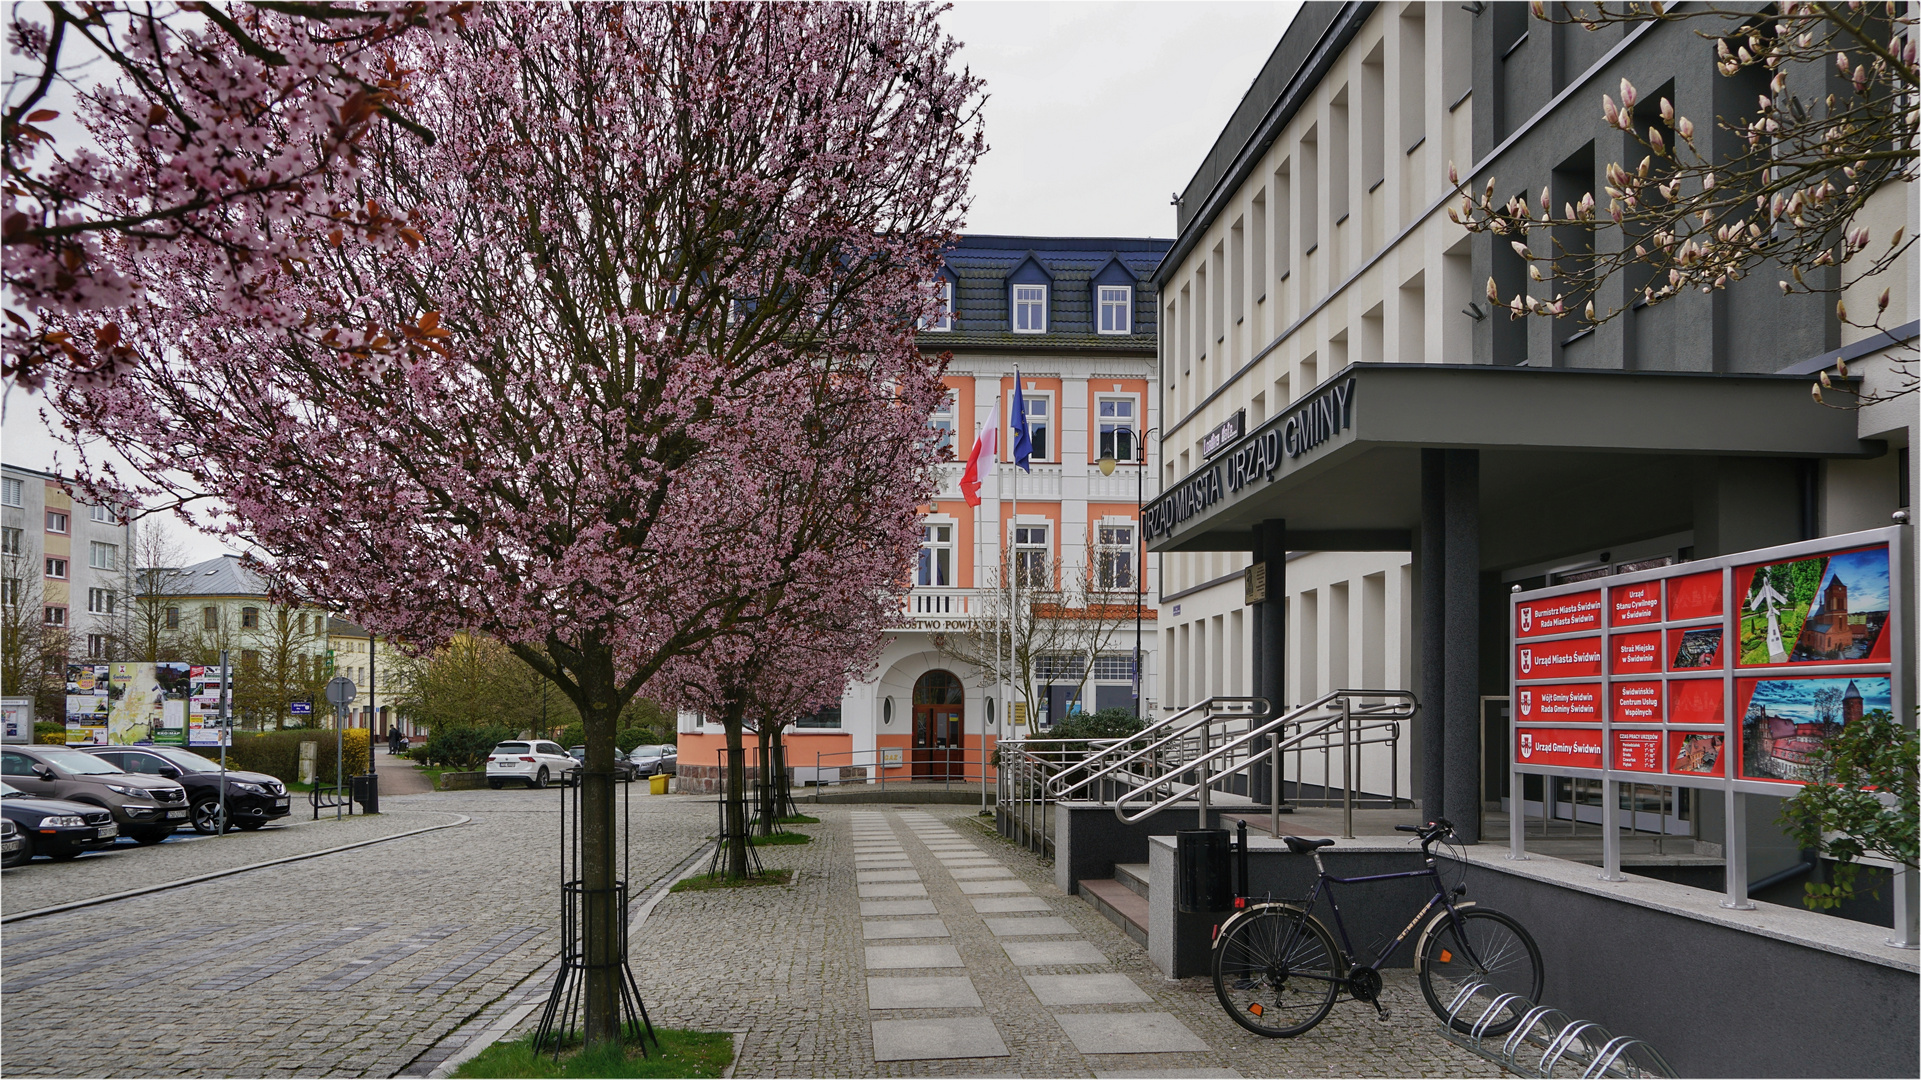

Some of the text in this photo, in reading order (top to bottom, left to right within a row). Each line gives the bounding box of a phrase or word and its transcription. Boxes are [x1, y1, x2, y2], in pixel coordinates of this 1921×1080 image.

[1141, 378, 1356, 541] URZĄD MIASTA URZĄD GMINY
[1629, 590, 1644, 598] Urząd
[1535, 601, 1601, 618] Burmistrz Miasta Świdwin
[1632, 599, 1657, 609] Cywilnego
[1627, 609, 1651, 619] Świdwinie
[1541, 614, 1594, 628] Rada Miasta Świdwin
[1621, 644, 1655, 653] Straż Miejska
[1534, 651, 1601, 667] Urząd Miasta Świdwin
[1627, 654, 1653, 663] Świdwinie
[1541, 691, 1593, 703] Wójt Gminy Świdwin
[1541, 703, 1594, 714] Rada Gminy Świdwin
[1625, 708, 1652, 717] Wspólnych
[1535, 741, 1601, 755] Urząd Gminy Świdwin
